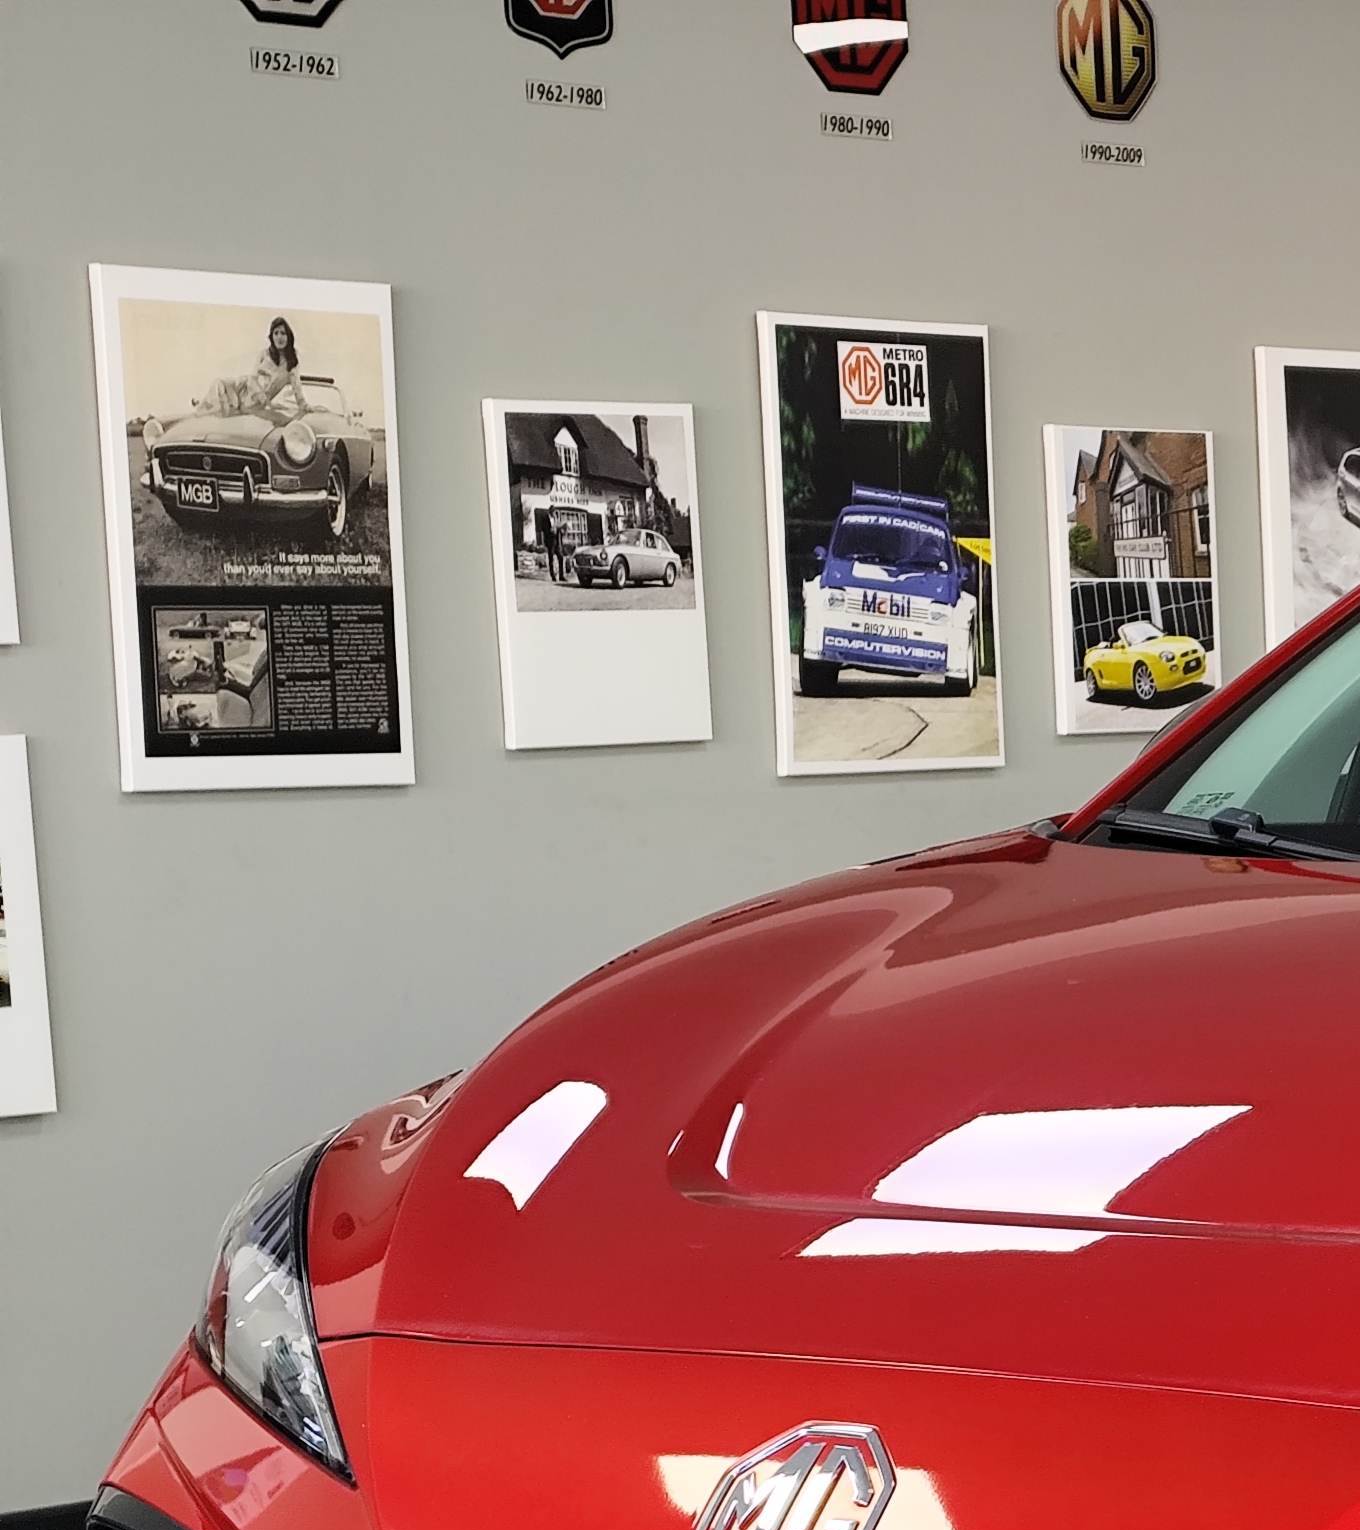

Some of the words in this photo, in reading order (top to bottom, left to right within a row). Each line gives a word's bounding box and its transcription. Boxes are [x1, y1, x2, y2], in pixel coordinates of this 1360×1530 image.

[254, 50, 335, 76] 1952-1962
[530, 82, 603, 106] 1962-1980
[823, 114, 890, 137] 1980-1990
[1084, 143, 1143, 164] 1990-2009
[882, 347, 924, 362] METRO
[883, 362, 926, 408] 6R4
[181, 482, 213, 504] MGB
[551, 480, 586, 495] LOUGH
[841, 514, 878, 525] FIRST
[878, 515, 892, 526] IN
[223, 563, 246, 574] than
[273, 565, 294, 574] ever
[296, 565, 313, 576] say
[314, 563, 341, 575] about
[279, 552, 287, 563] It
[287, 553, 310, 565] says
[311, 554, 335, 564] more
[336, 552, 362, 564] about
[363, 554, 381, 566] you
[824, 635, 946, 661] COMPUTERVISION
